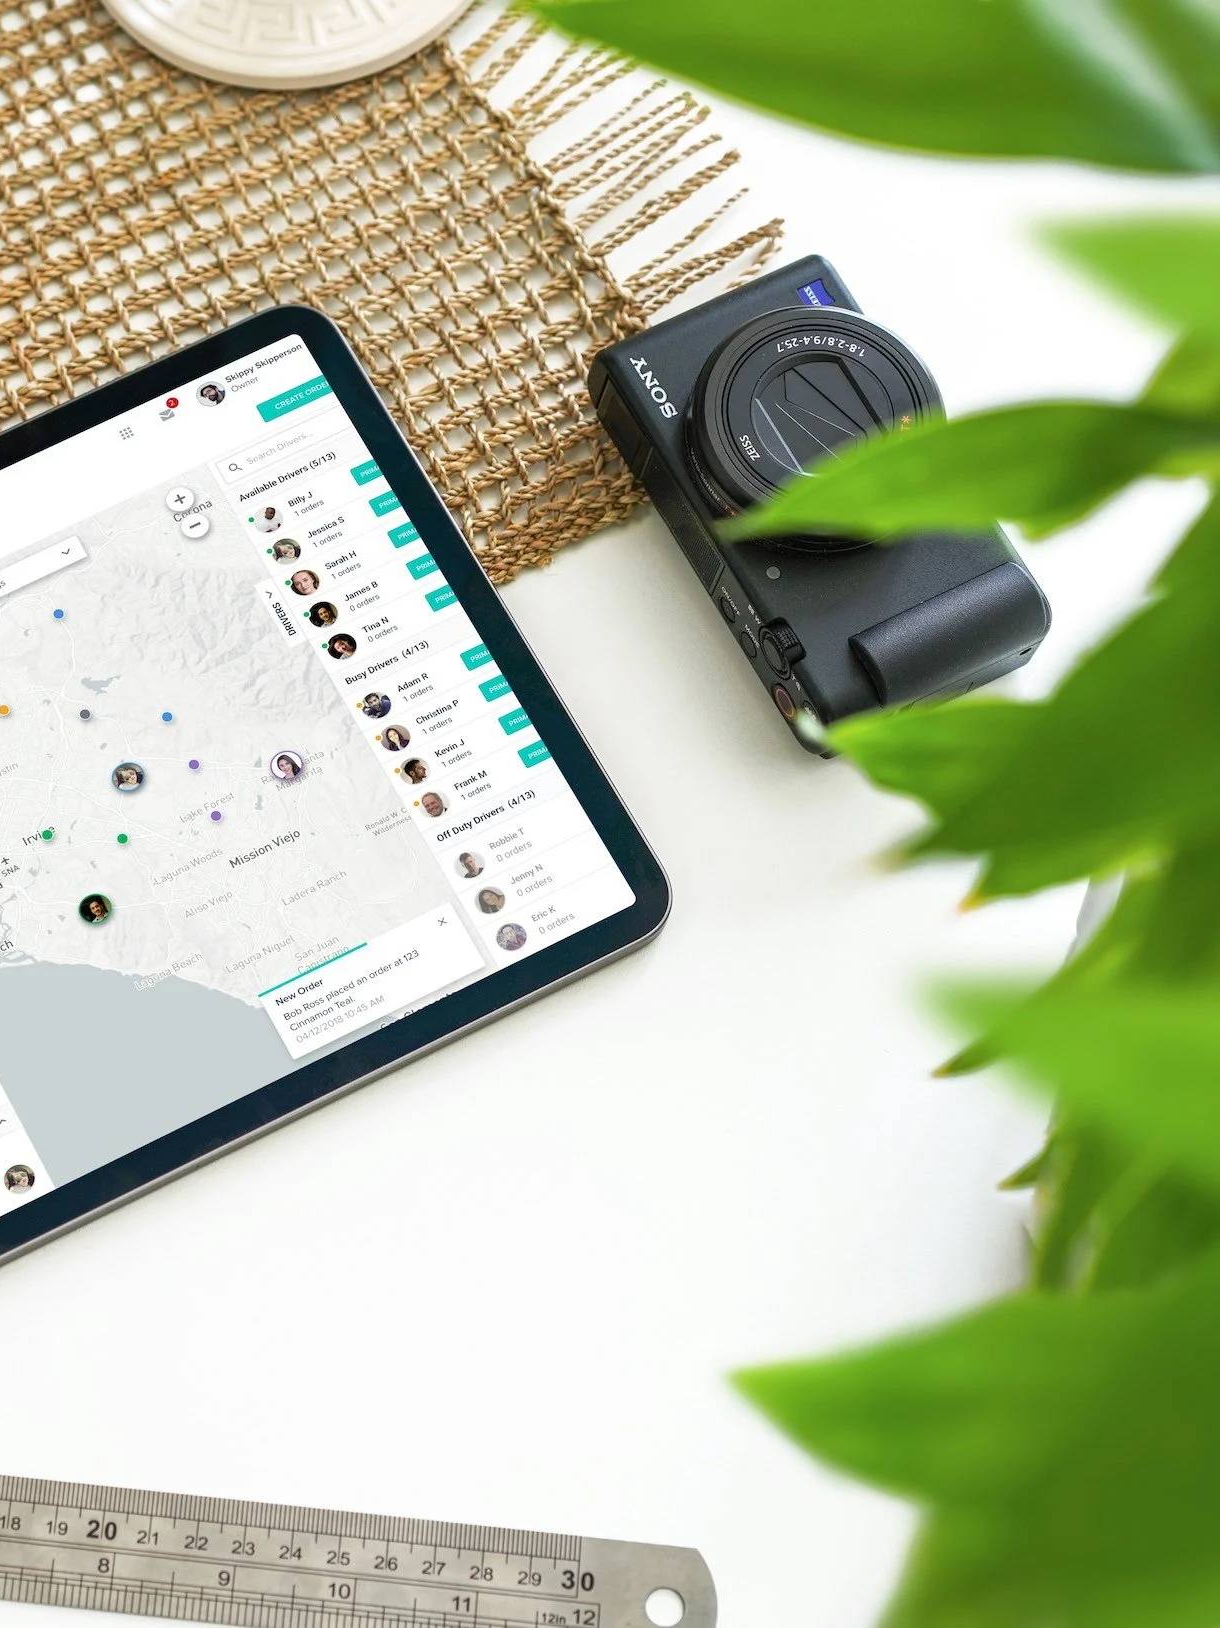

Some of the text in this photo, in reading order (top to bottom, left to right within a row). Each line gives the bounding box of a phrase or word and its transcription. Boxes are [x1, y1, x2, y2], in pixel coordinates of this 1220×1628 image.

[224, 344, 303, 383] Skippy Skipperson
[230, 376, 259, 393] Owner
[274, 391, 305, 410] CREATE
[629, 357, 678, 418] SONY
[739, 434, 761, 461] ZEISS
[239, 451, 336, 502] Available Drivers (5/13)
[287, 495, 306, 507] Billy
[307, 521, 338, 539] Jessica
[271, 601, 297, 636] DRIVERS
[744, 624, 761, 648] MODE
[344, 640, 429, 685] Busy Drivers (4/13)
[436, 789, 536, 842] Off Duty Drivers (4/13)
[228, 830, 301, 869] Mission Viejo
[274, 979, 323, 1006] New Order
[283, 949, 420, 1021] Bob Ross placed an order at 123
[289, 1006, 334, 1031] Cinnamon
[86, 1519, 118, 1541] 20
[561, 1570, 596, 1591] 30
[98, 1558, 110, 1573] 8
[328, 1583, 351, 1600] 10
[452, 1596, 471, 1613] 11
